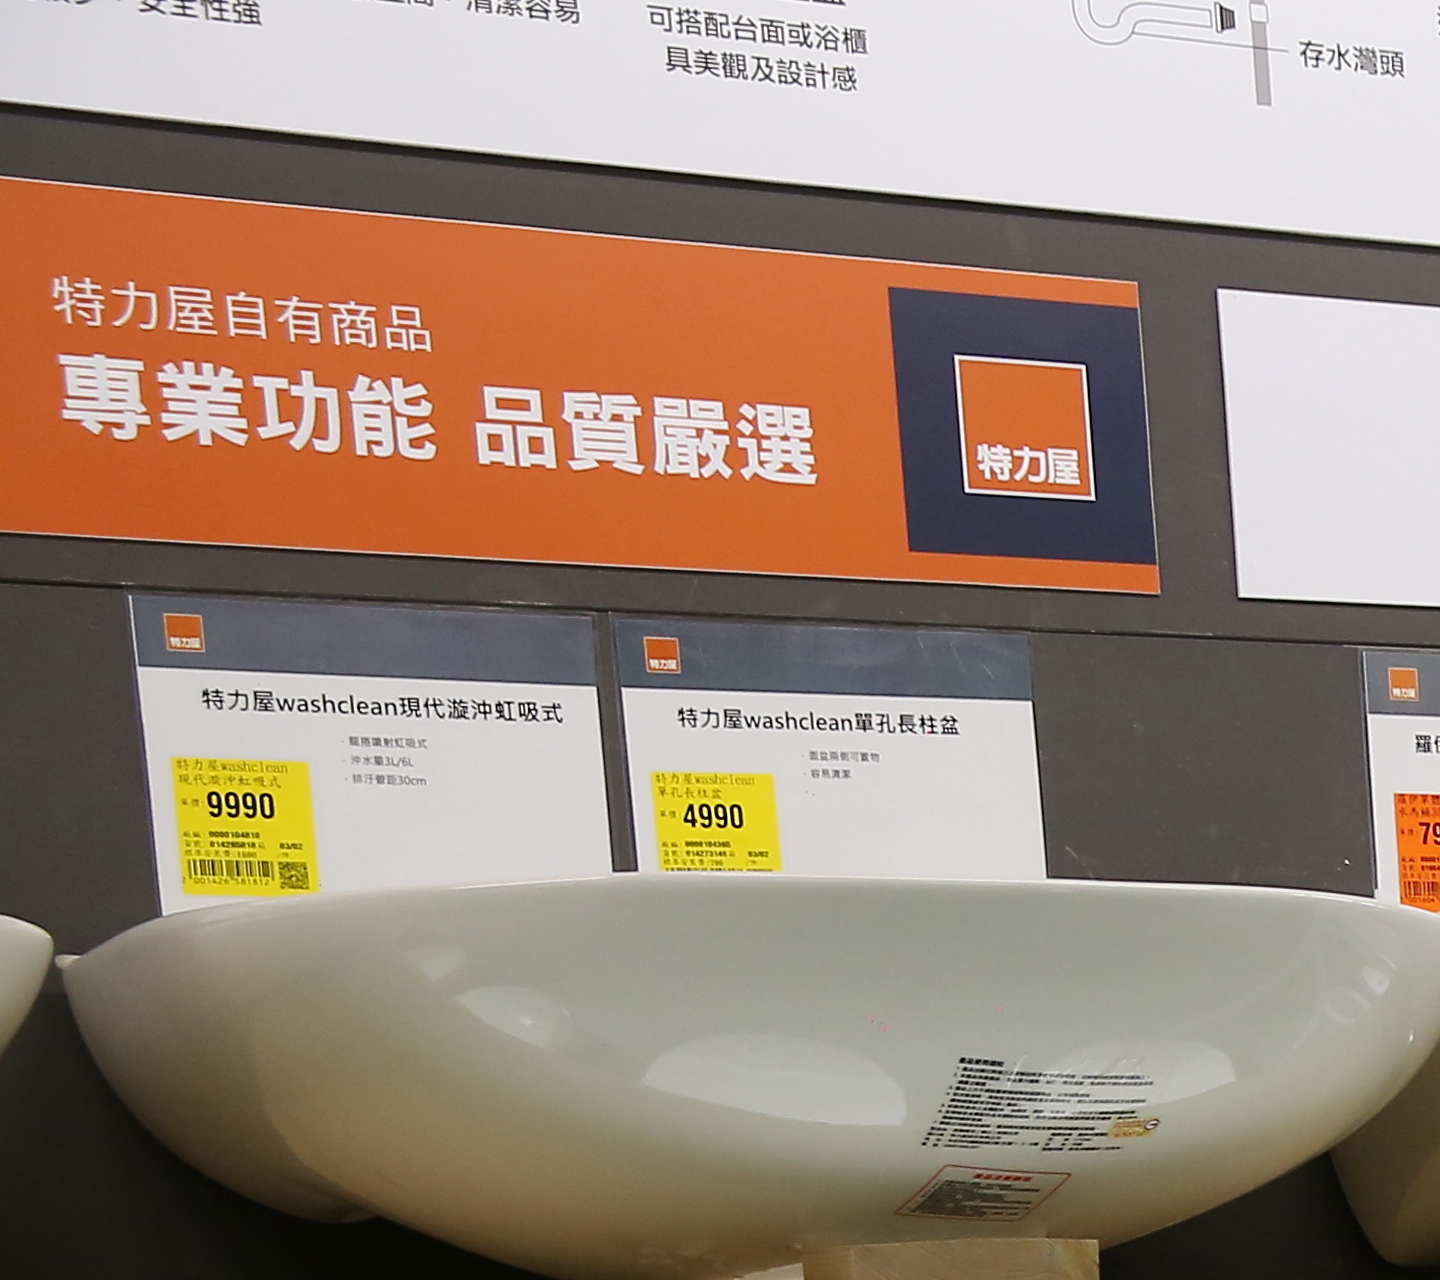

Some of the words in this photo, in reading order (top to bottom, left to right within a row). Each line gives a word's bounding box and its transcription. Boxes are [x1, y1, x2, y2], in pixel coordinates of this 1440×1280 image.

[646, 4, 870, 56] 可搭配台面或浴櫃
[665, 46, 859, 93] 具美觀及設計感
[1298, 40, 1407, 79] 存水灣頭
[52, 274, 434, 353] 特力屋自有商品
[57, 353, 438, 462] 專業功能
[476, 384, 819, 486] 品質嚴選
[976, 443, 1081, 487] 特力屋
[201, 688, 564, 725] 特力屋washclean現代漩沖虹吸式
[677, 706, 960, 736] 特力屋washclean單孔長柱盆
[206, 790, 276, 820] 9990
[683, 803, 744, 830] 4990
